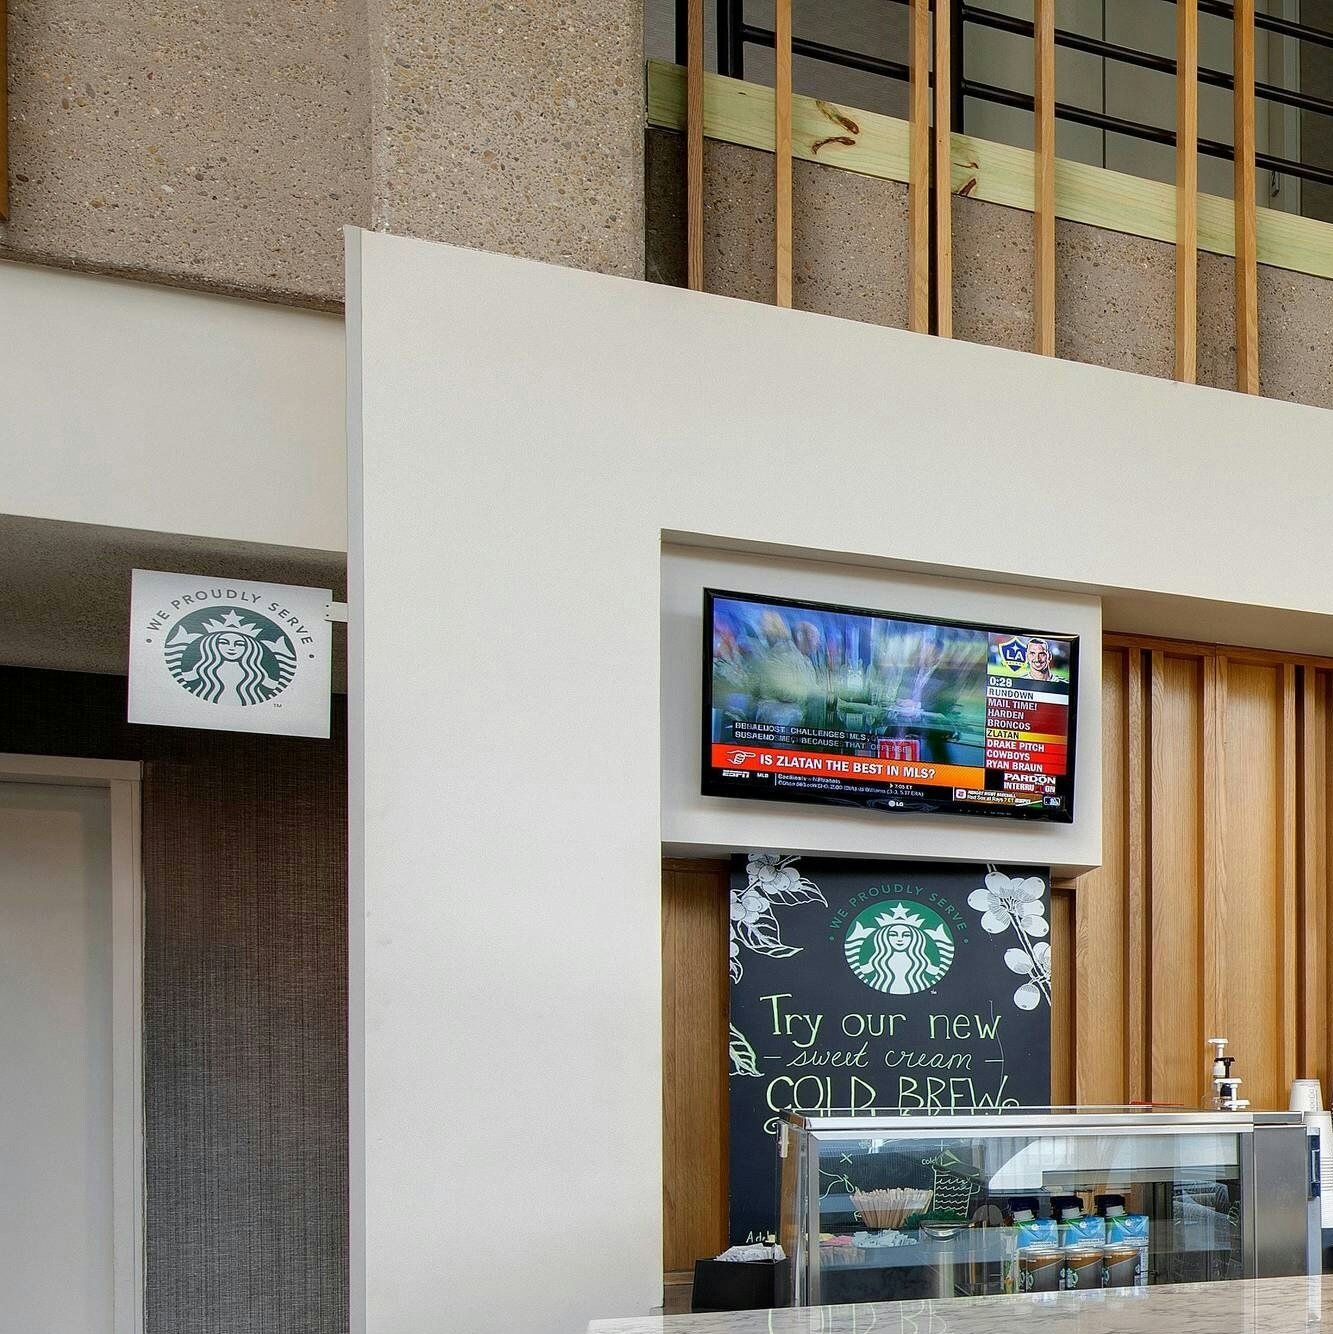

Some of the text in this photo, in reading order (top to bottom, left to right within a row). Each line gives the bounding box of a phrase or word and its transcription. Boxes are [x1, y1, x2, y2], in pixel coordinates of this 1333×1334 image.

[147, 589, 313, 645] WE PROUDLY SERVE
[1006, 650, 1024, 661] LA
[989, 677, 1013, 687] 0:28
[988, 688, 1034, 700] RUNDOWN
[988, 699, 1038, 711] MAIL TIME!
[987, 709, 1024, 720] HARDEN
[987, 719, 1031, 731] BRONCOS
[987, 729, 1020, 740] ZLATAN
[801, 738, 839, 748] BECAUSE
[844, 742, 866, 750] THAT
[987, 739, 1045, 752] DRAKE PITCH
[986, 749, 1031, 761] COWBOYS
[760, 753, 937, 779] IS ZLATAN THE BEST IN MLS?
[986, 760, 1043, 772] RYAN BRAUN
[722, 770, 751, 778] ESPN
[1003, 773, 1057, 785] PARDON
[1003, 781, 1056, 793] INTERRUON
[829, 883, 968, 931] WE PROUDLY SERVE
[760, 993, 1002, 1048] Try our new
[786, 1042, 973, 1071] sweet cream
[766, 1075, 1008, 1117] COLD BREW
